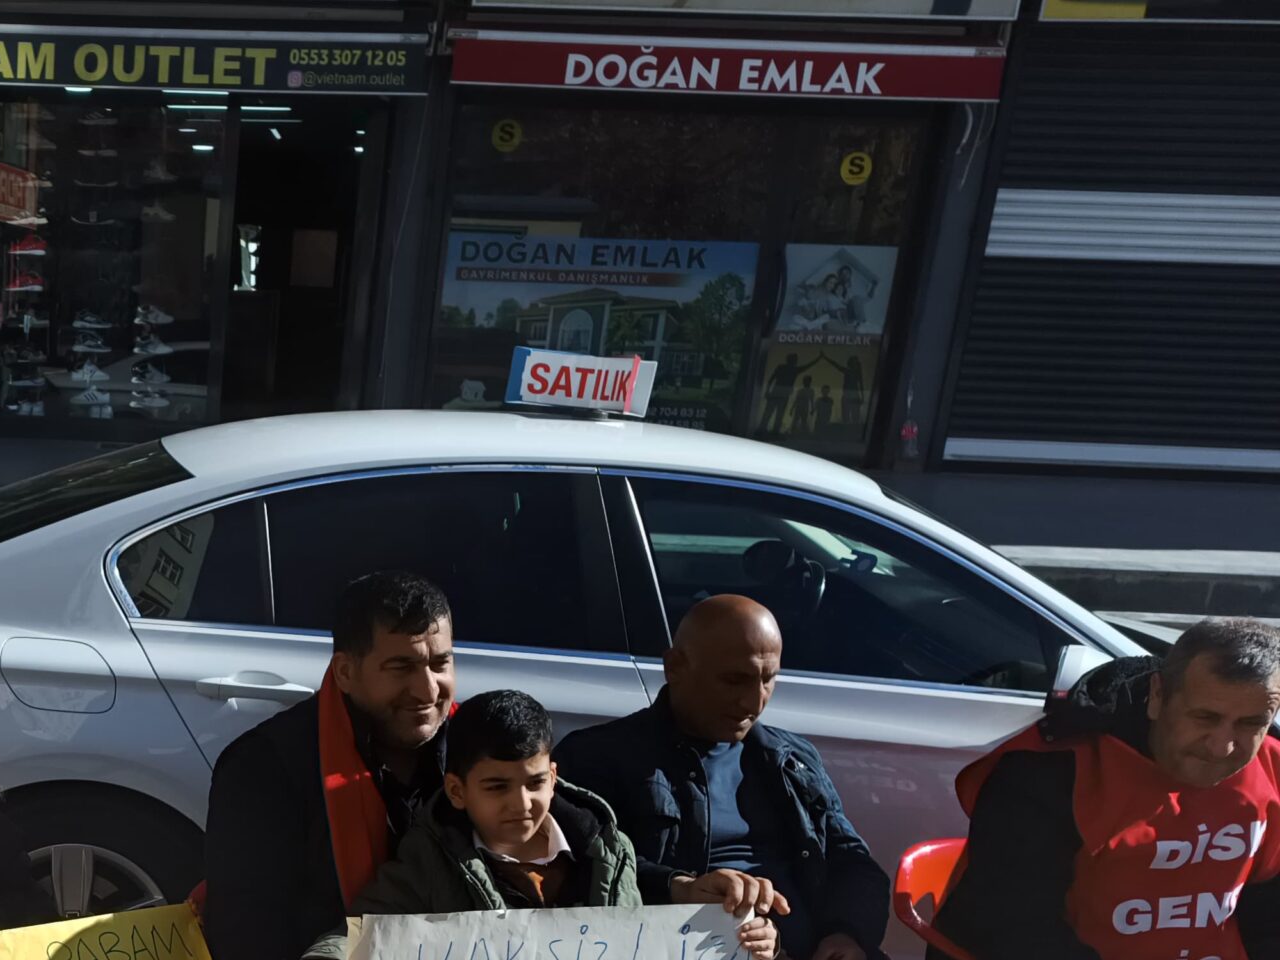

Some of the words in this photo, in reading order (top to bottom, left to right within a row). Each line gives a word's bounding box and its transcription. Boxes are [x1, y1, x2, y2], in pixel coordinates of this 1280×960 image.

[73, 42, 277, 86] OUTLET
[289, 48, 329, 66] 0553
[331, 49, 362, 66] 307
[365, 50, 384, 66] 12
[386, 50, 407, 67] 05
[564, 45, 721, 91] DOĞAN
[738, 58, 886, 95] EMLAK
[848, 156, 865, 175] S
[460, 232, 576, 266] DOĞAN
[591, 243, 708, 270] EMLAK
[827, 335, 871, 345] EMLAK
[527, 363, 632, 403] SATILIK
